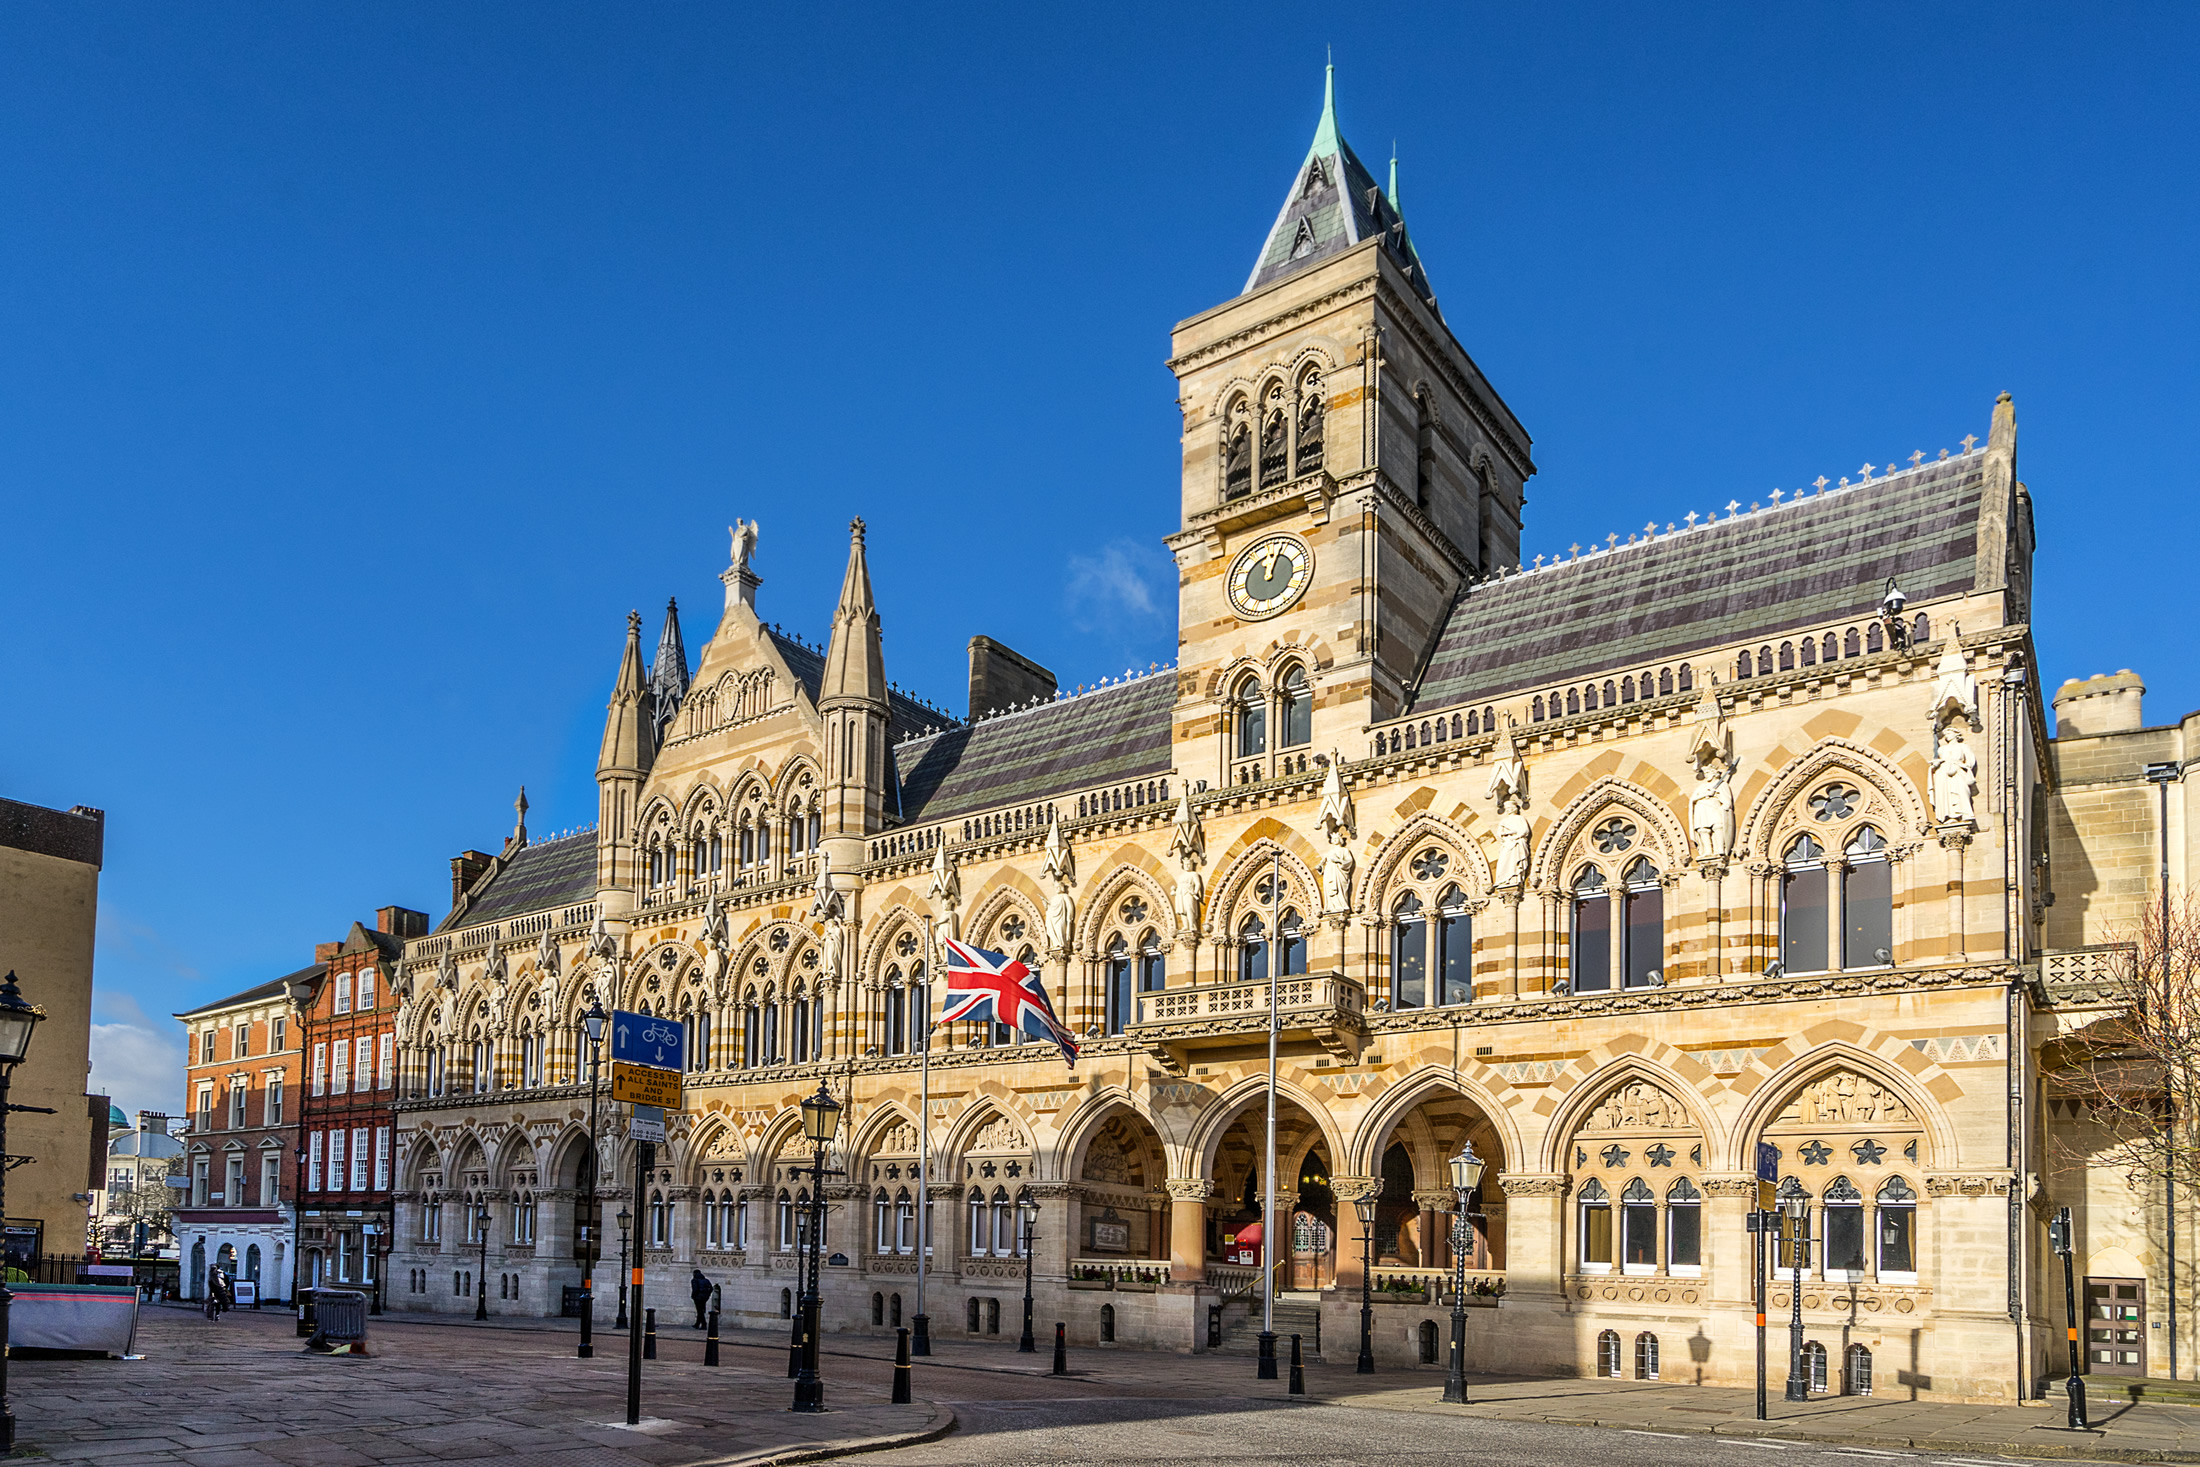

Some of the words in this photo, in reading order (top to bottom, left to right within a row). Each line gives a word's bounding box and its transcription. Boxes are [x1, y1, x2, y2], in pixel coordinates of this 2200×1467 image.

[628, 1068, 665, 1080] ACCESS
[667, 1074, 679, 1082] TO
[627, 1076, 644, 1084] ALL
[646, 1079, 679, 1090] SAINTS
[644, 1086, 663, 1095] AND
[629, 1092, 663, 1103] BRIDGE
[665, 1097, 677, 1105] ST
